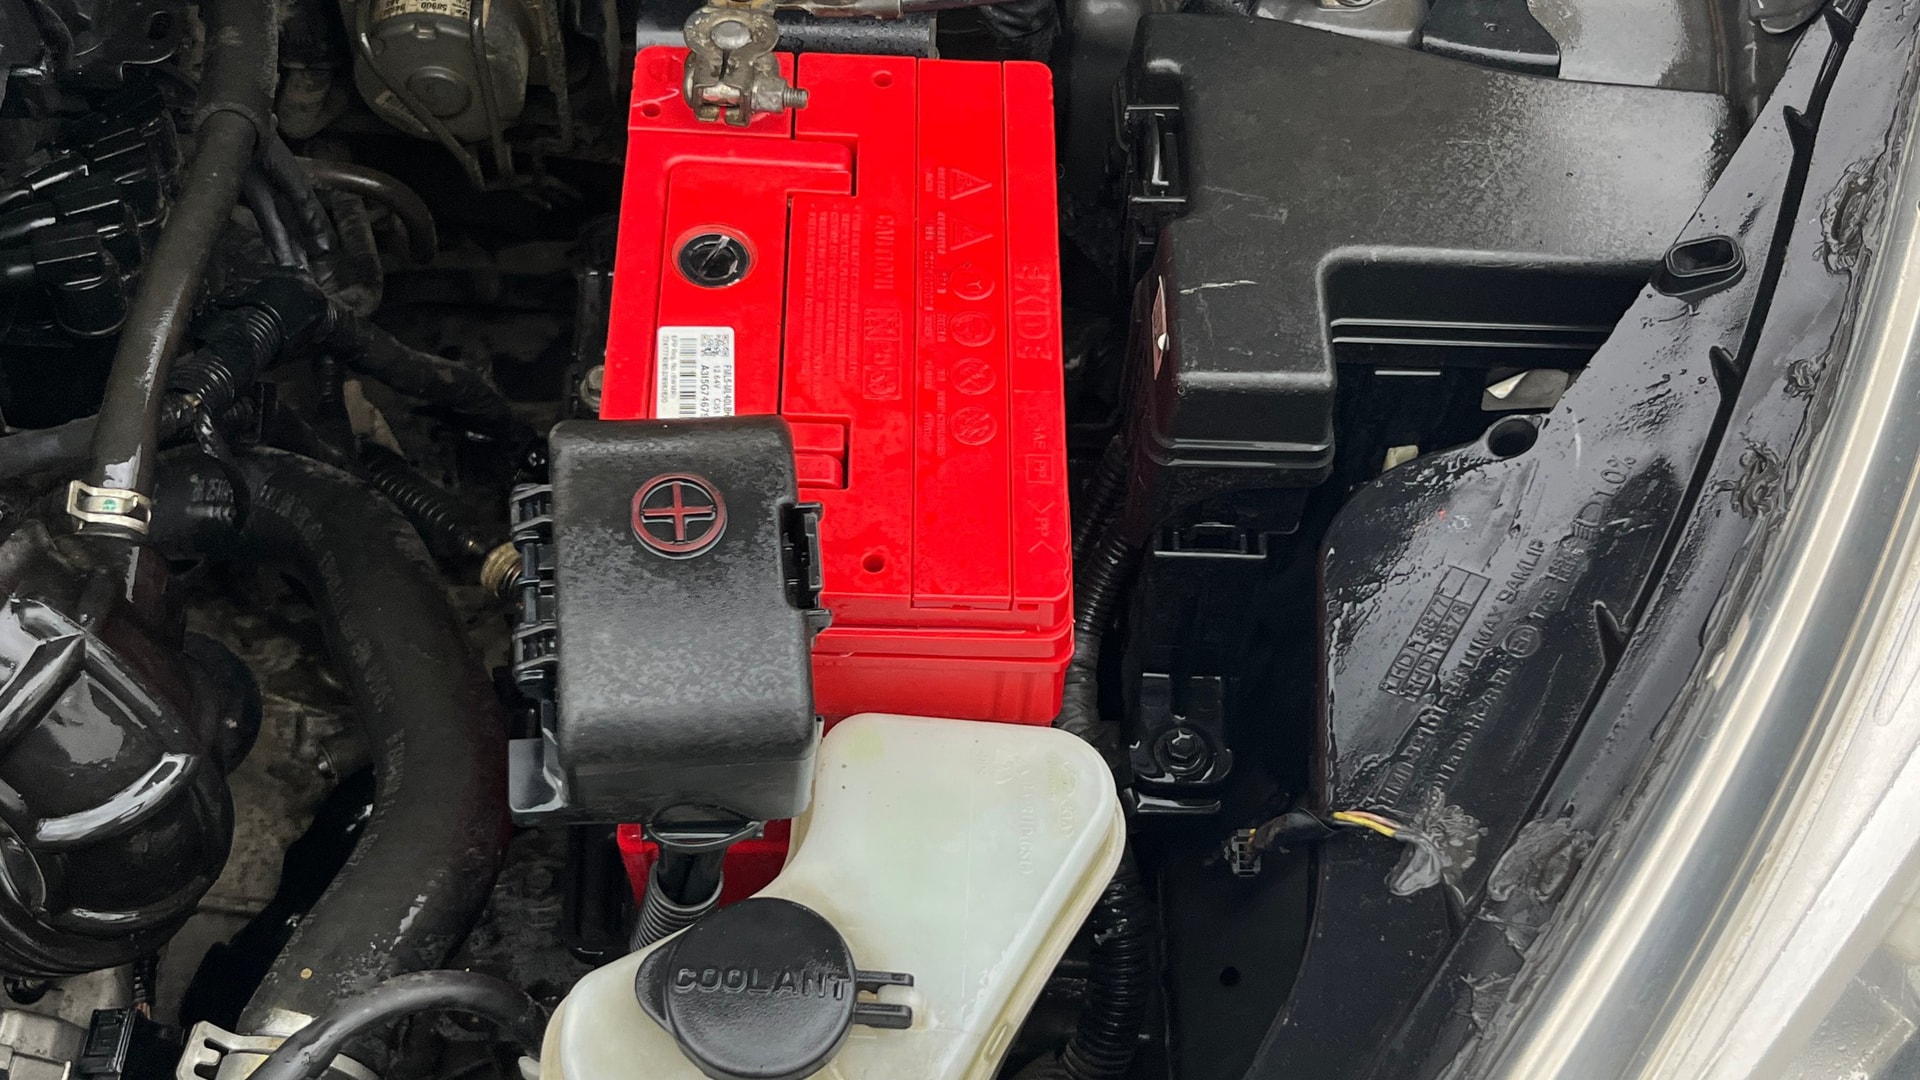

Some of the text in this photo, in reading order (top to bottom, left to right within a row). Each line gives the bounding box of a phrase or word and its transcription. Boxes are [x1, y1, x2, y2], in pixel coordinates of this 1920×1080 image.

[1459, 602, 1508, 670] LUMAX
[1381, 651, 1416, 692] LHD
[673, 966, 851, 1001] COOLANT
